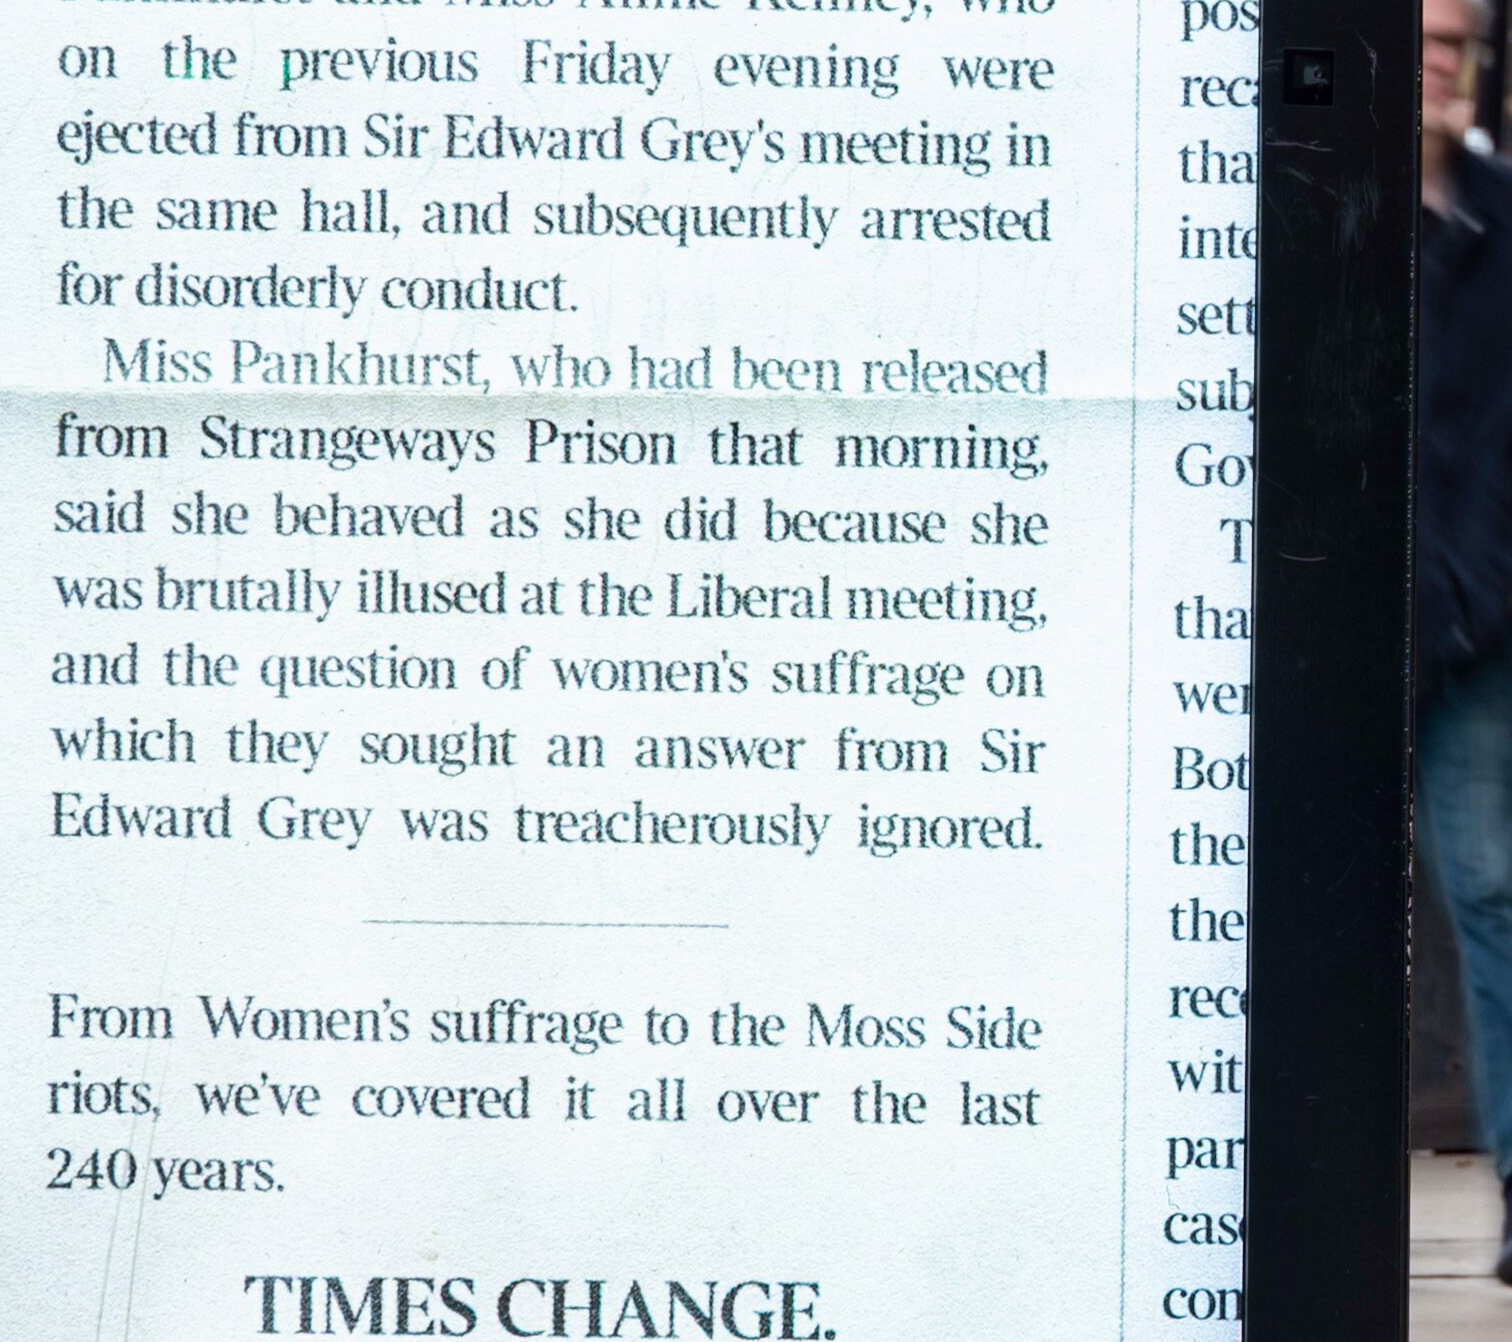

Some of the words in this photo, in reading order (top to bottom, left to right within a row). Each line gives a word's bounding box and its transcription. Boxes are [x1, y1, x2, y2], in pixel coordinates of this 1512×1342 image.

[58, 45, 117, 79] on
[162, 34, 237, 81] the
[279, 36, 479, 92] previous
[523, 39, 671, 97] Friday
[714, 42, 900, 98] evening
[942, 56, 1055, 91] were
[56, 108, 218, 166] ejected
[233, 110, 347, 158] from
[364, 112, 430, 159] Sir
[444, 113, 624, 161] Edward
[640, 116, 785, 174] Grey's
[800, 119, 992, 176] meeting
[1006, 121, 1051, 167] in
[57, 184, 134, 230] the
[156, 198, 278, 232] same
[301, 187, 401, 238] hall,
[421, 190, 510, 235] and
[534, 191, 839, 250] subsequently
[860, 197, 1052, 242] arrested
[57, 260, 124, 307] for
[135, 261, 368, 320] disorderly
[381, 265, 578, 312] conduct.
[104, 337, 212, 382] Miss
[232, 339, 491, 395] Pankhurst,
[511, 343, 612, 387] who
[628, 344, 711, 390] had
[732, 345, 841, 392] been
[862, 348, 1047, 394] released
[56, 410, 169, 459] from
[200, 414, 496, 473] Strangeways
[525, 418, 676, 466] Prison
[708, 420, 804, 467] that
[835, 423, 1049, 481] morning,
[54, 488, 145, 534] said
[171, 489, 249, 536] she
[273, 491, 464, 538] behaved
[489, 506, 539, 539] as
[564, 495, 641, 541] she
[663, 495, 737, 542] did
[763, 497, 947, 544] because
[971, 501, 1049, 546] she
[53, 575, 143, 611] was
[155, 565, 342, 623] brutally
[357, 568, 507, 615] illused
[520, 577, 563, 616] at
[579, 571, 653, 617] the
[667, 572, 832, 620] Liberal
[845, 576, 1047, 633] meeting,
[51, 641, 138, 686] and
[163, 641, 239, 687] the
[260, 644, 456, 699] question
[481, 644, 532, 691] of
[551, 649, 749, 694] women's
[771, 649, 965, 707] suffrage
[985, 664, 1044, 698] on
[50, 716, 196, 763] which
[226, 718, 329, 775] they
[360, 721, 517, 777] sought
[547, 734, 605, 768] an
[634, 735, 807, 770] answer
[837, 726, 949, 773] from
[981, 728, 1047, 774] Sir
[52, 791, 232, 839] Edward
[257, 795, 372, 851] Grey
[400, 809, 489, 842] was
[514, 799, 831, 857] treacherously
[858, 802, 1043, 858] ignored.
[49, 992, 173, 1040] From
[198, 994, 410, 1042] Women's
[430, 998, 623, 1055] suffrage
[644, 1006, 689, 1046] to
[711, 1001, 786, 1047] the
[807, 1002, 926, 1048] Moss
[946, 1004, 1043, 1051] Side
[47, 1068, 161, 1118] riots,
[194, 1071, 321, 1117] we've
[351, 1075, 531, 1120] covered
[565, 1075, 595, 1121] it
[627, 1077, 686, 1122] all
[717, 1089, 821, 1123] over
[852, 1079, 927, 1125] the
[960, 1080, 1041, 1127] last
[46, 1147, 138, 1190] 240
[152, 1157, 285, 1201] years.
[243, 1275, 478, 1338] TIMES
[496, 1277, 837, 1342] CHANGE.
